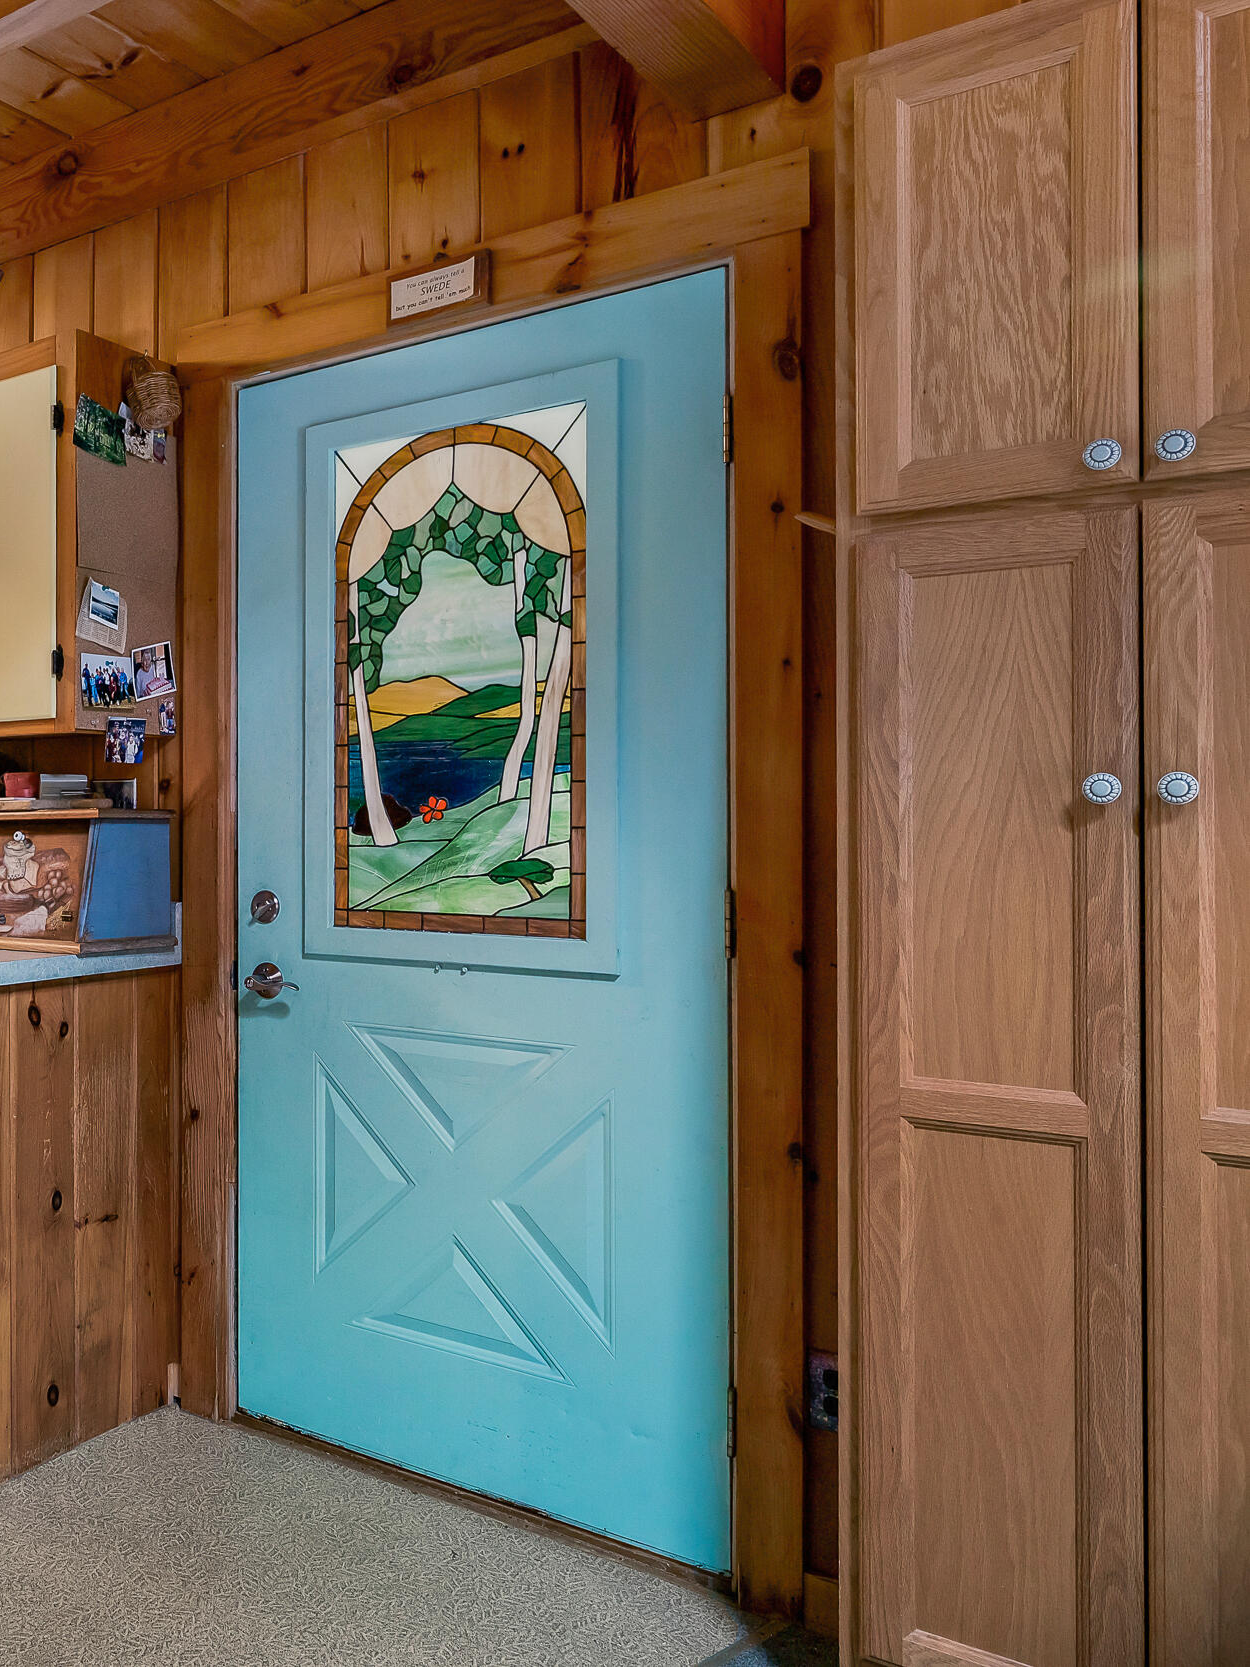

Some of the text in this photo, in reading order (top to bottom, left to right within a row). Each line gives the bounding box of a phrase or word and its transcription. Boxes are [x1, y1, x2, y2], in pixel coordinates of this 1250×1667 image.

[430, 274, 449, 283] always
[450, 269, 460, 277] tell
[420, 280, 452, 296] SWEDE
[395, 304, 405, 312] but
[407, 302, 417, 310] you
[418, 297, 433, 306] can't
[458, 285, 471, 294] much
